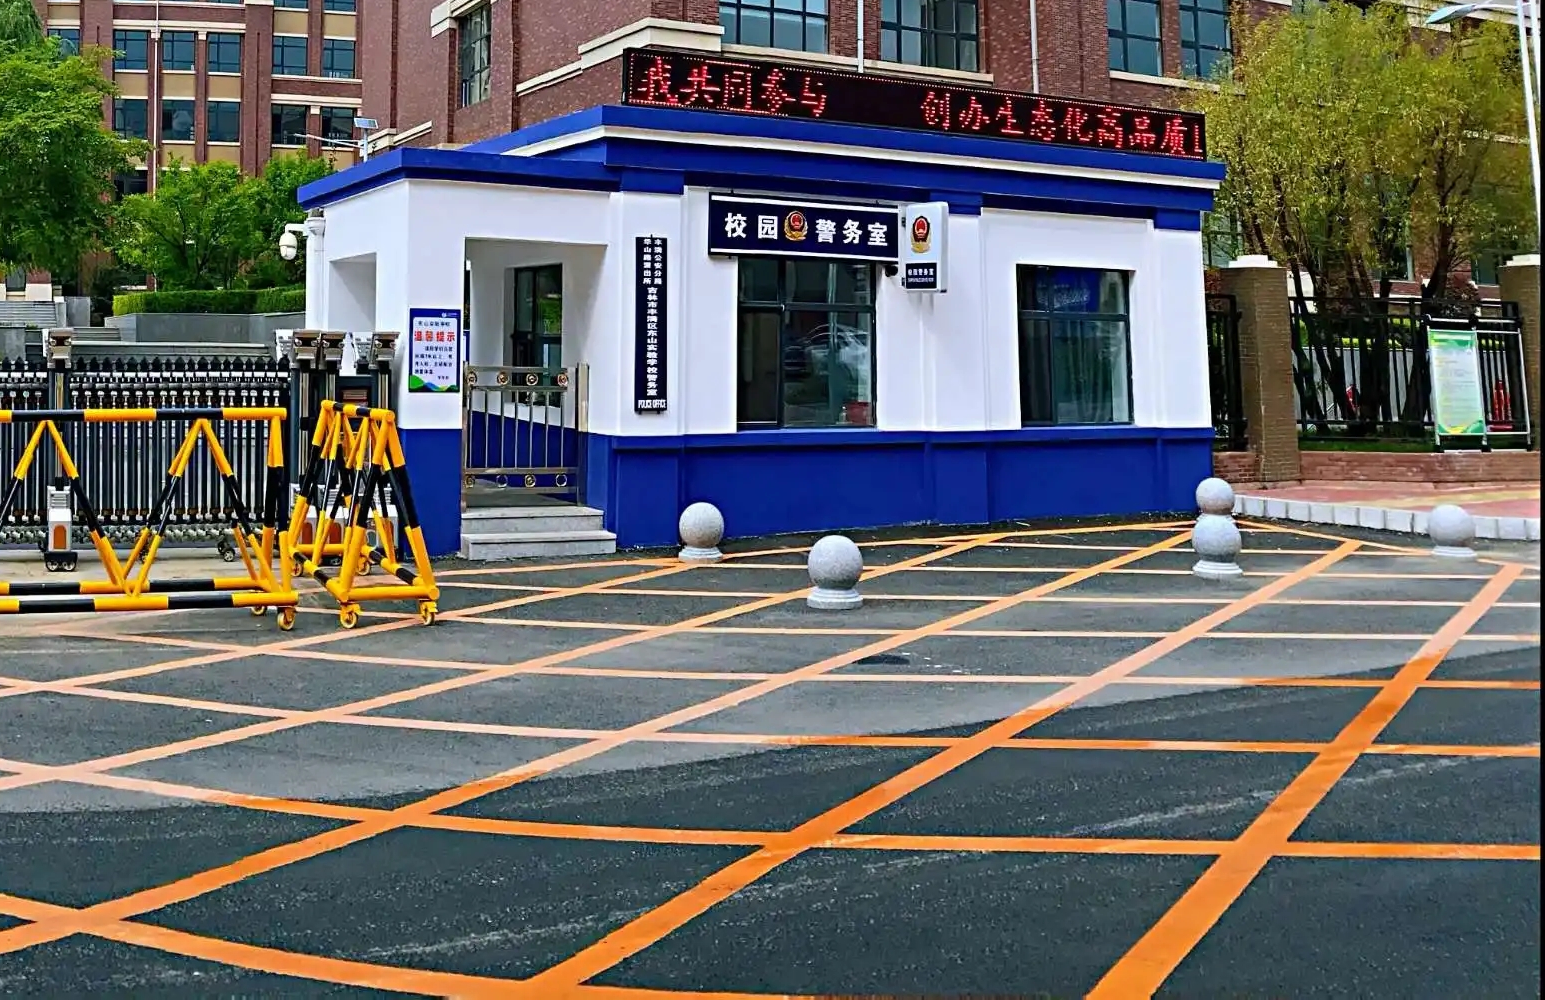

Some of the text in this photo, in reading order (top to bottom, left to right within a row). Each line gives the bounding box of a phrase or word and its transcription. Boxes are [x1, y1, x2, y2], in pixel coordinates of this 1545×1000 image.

[920, 90, 1203, 155] 创办生态化高品质
[724, 212, 888, 247] 校园警务室
[638, 399, 666, 409] POLICE OFFICE
